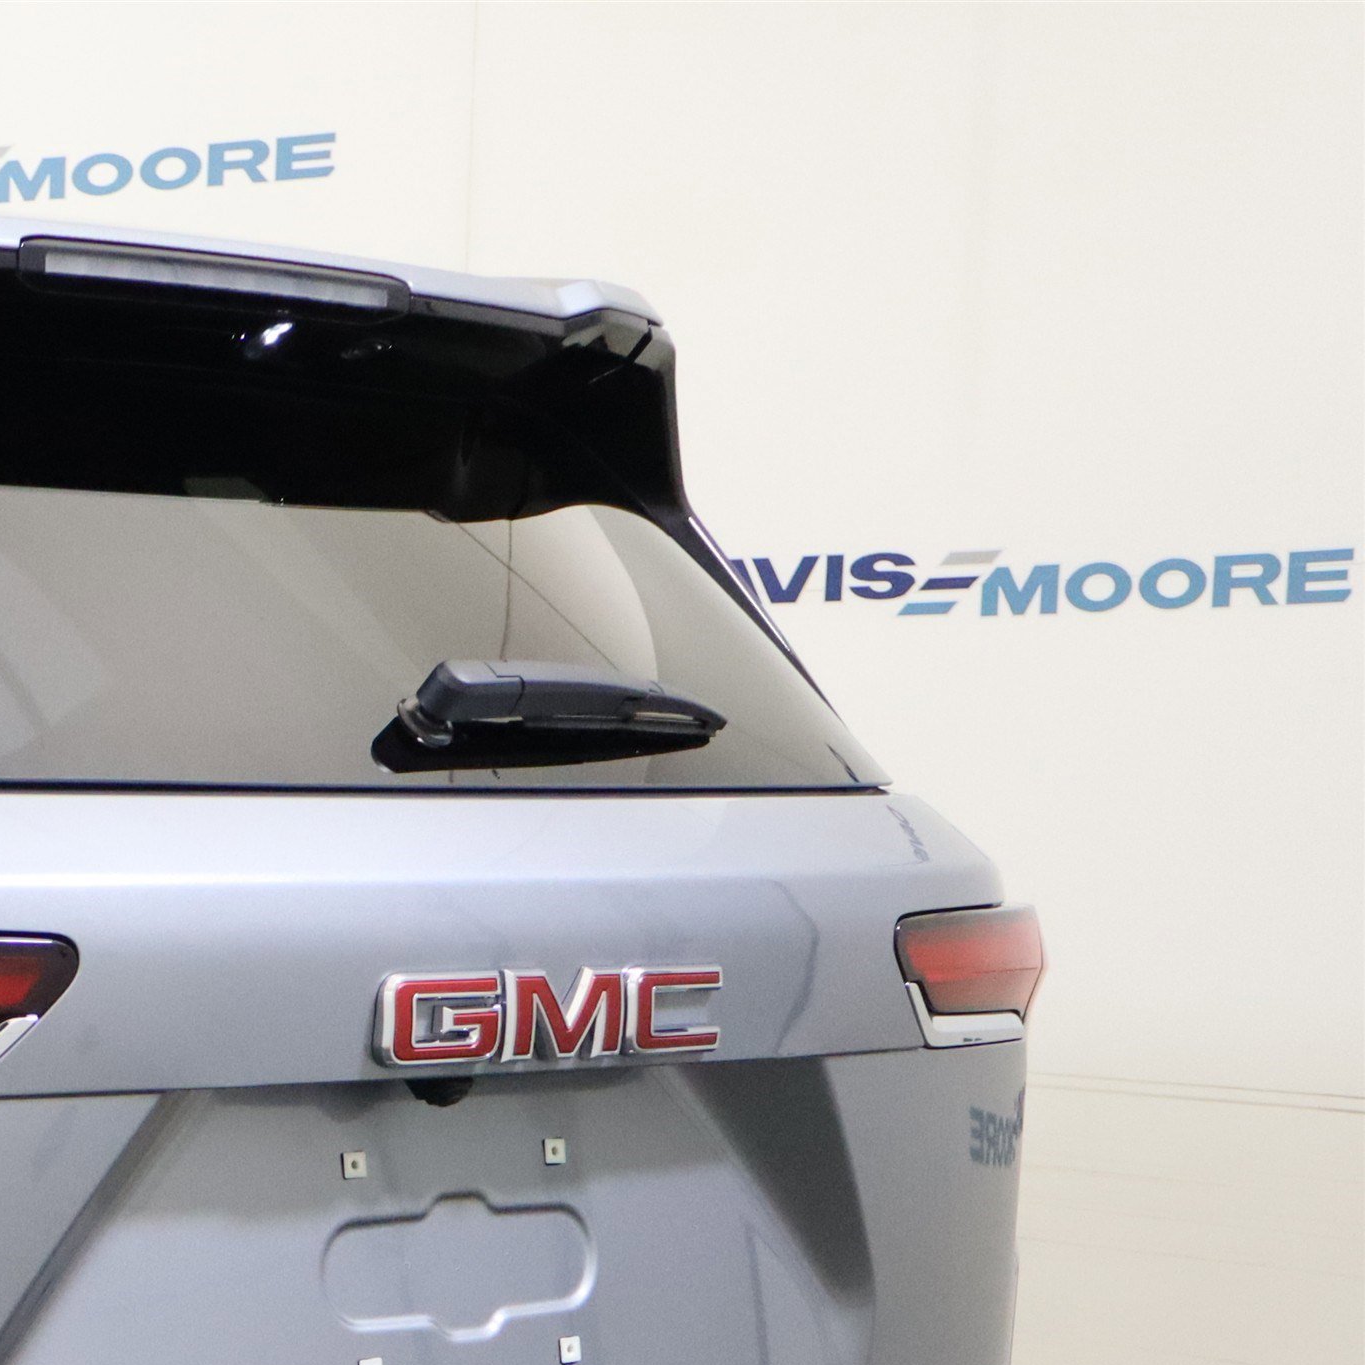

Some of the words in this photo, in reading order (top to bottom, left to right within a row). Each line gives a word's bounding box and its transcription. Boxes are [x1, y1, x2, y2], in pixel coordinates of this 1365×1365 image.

[728, 550, 916, 603] VIS
[979, 546, 1354, 617] MOORE
[374, 964, 723, 1068] GMC
